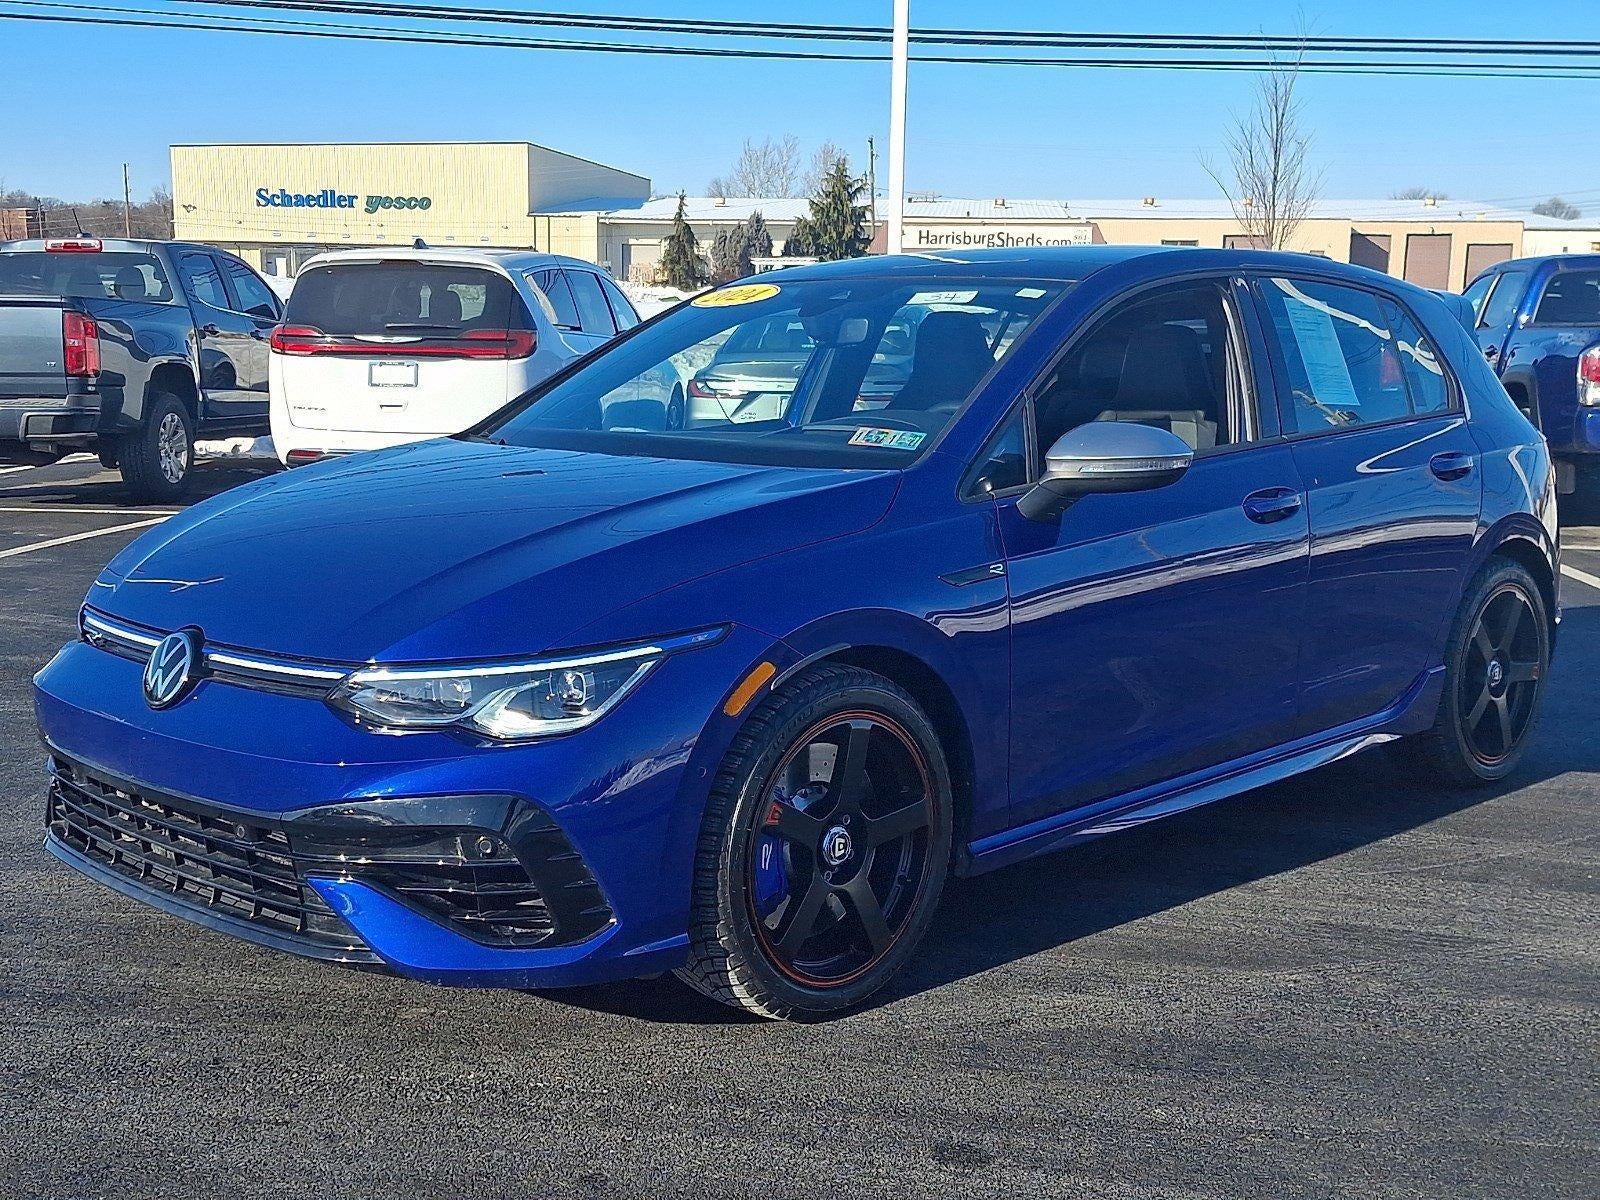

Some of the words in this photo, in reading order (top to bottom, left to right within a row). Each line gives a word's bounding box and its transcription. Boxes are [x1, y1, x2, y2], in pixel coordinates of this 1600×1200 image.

[256, 188, 358, 209] Schaedler
[364, 195, 432, 214] yesco
[918, 230, 1071, 247] HarrisburgShedscom
